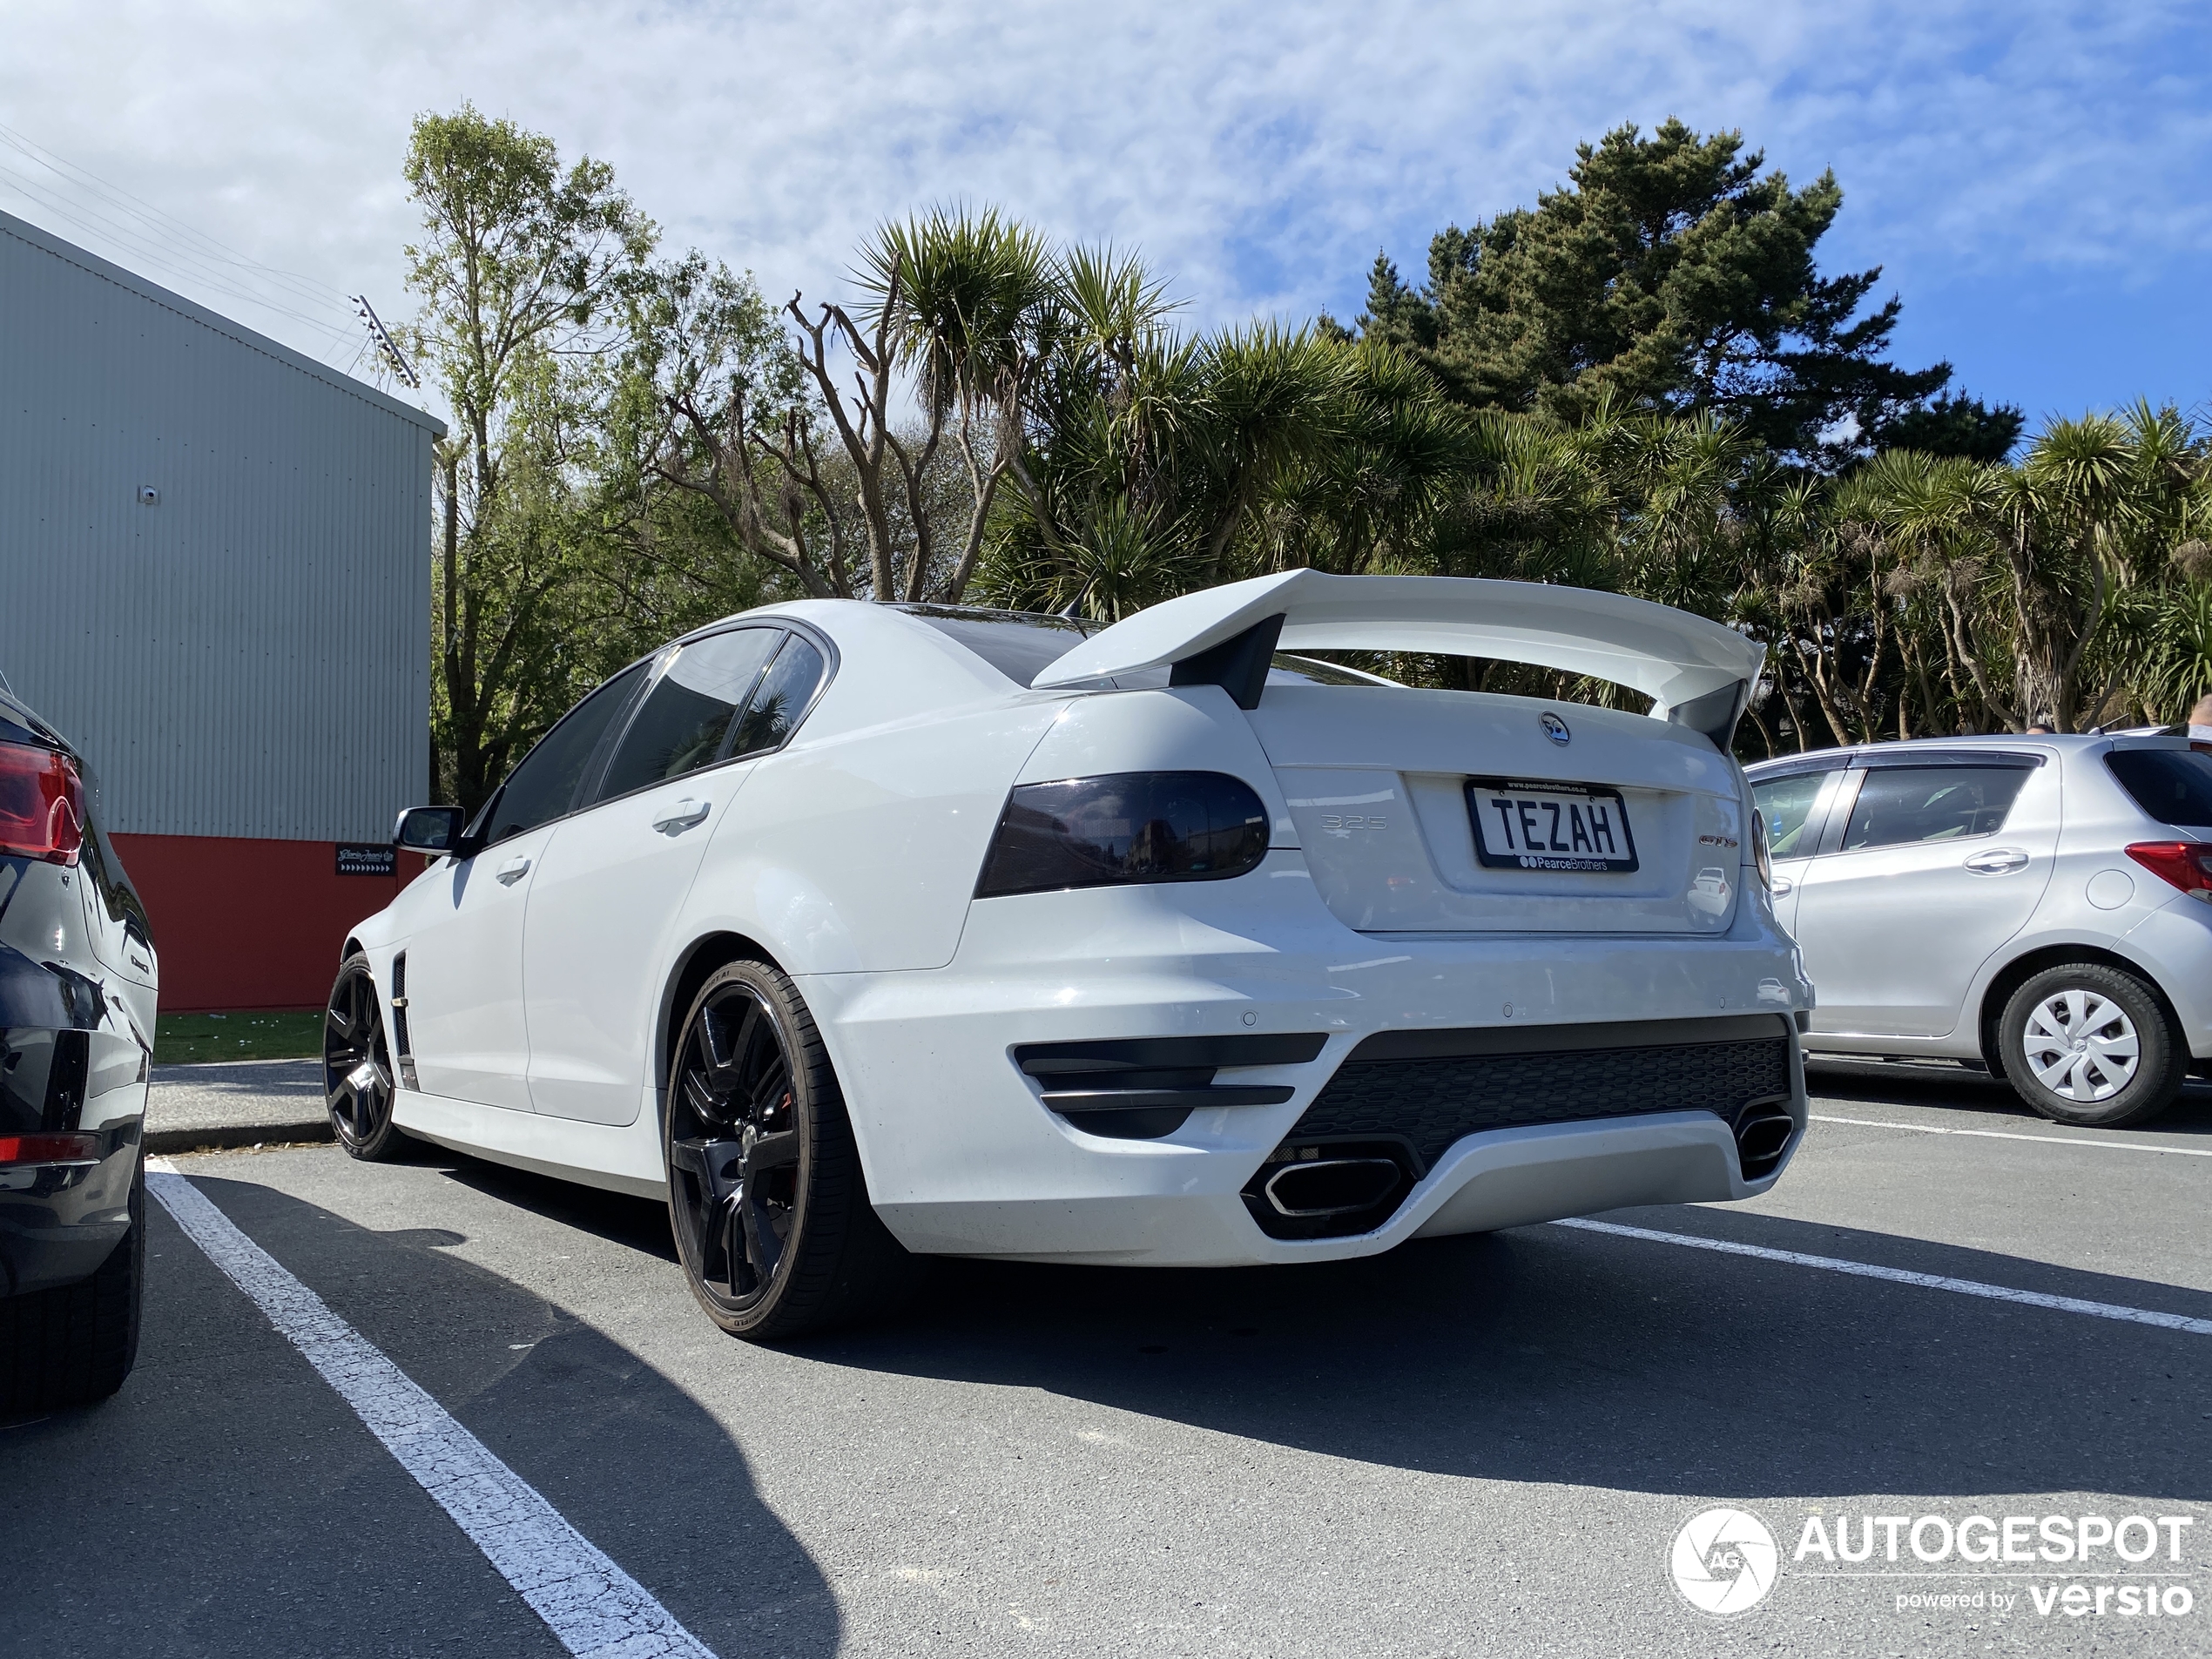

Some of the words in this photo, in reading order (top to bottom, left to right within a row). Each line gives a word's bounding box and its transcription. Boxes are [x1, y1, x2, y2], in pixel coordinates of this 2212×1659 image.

[1321, 814, 1387, 829] 325
[1491, 799, 1615, 853] TEZAH
[1699, 834, 1738, 848] GTS
[2092, 974, 2147, 1012] DUNLOP
